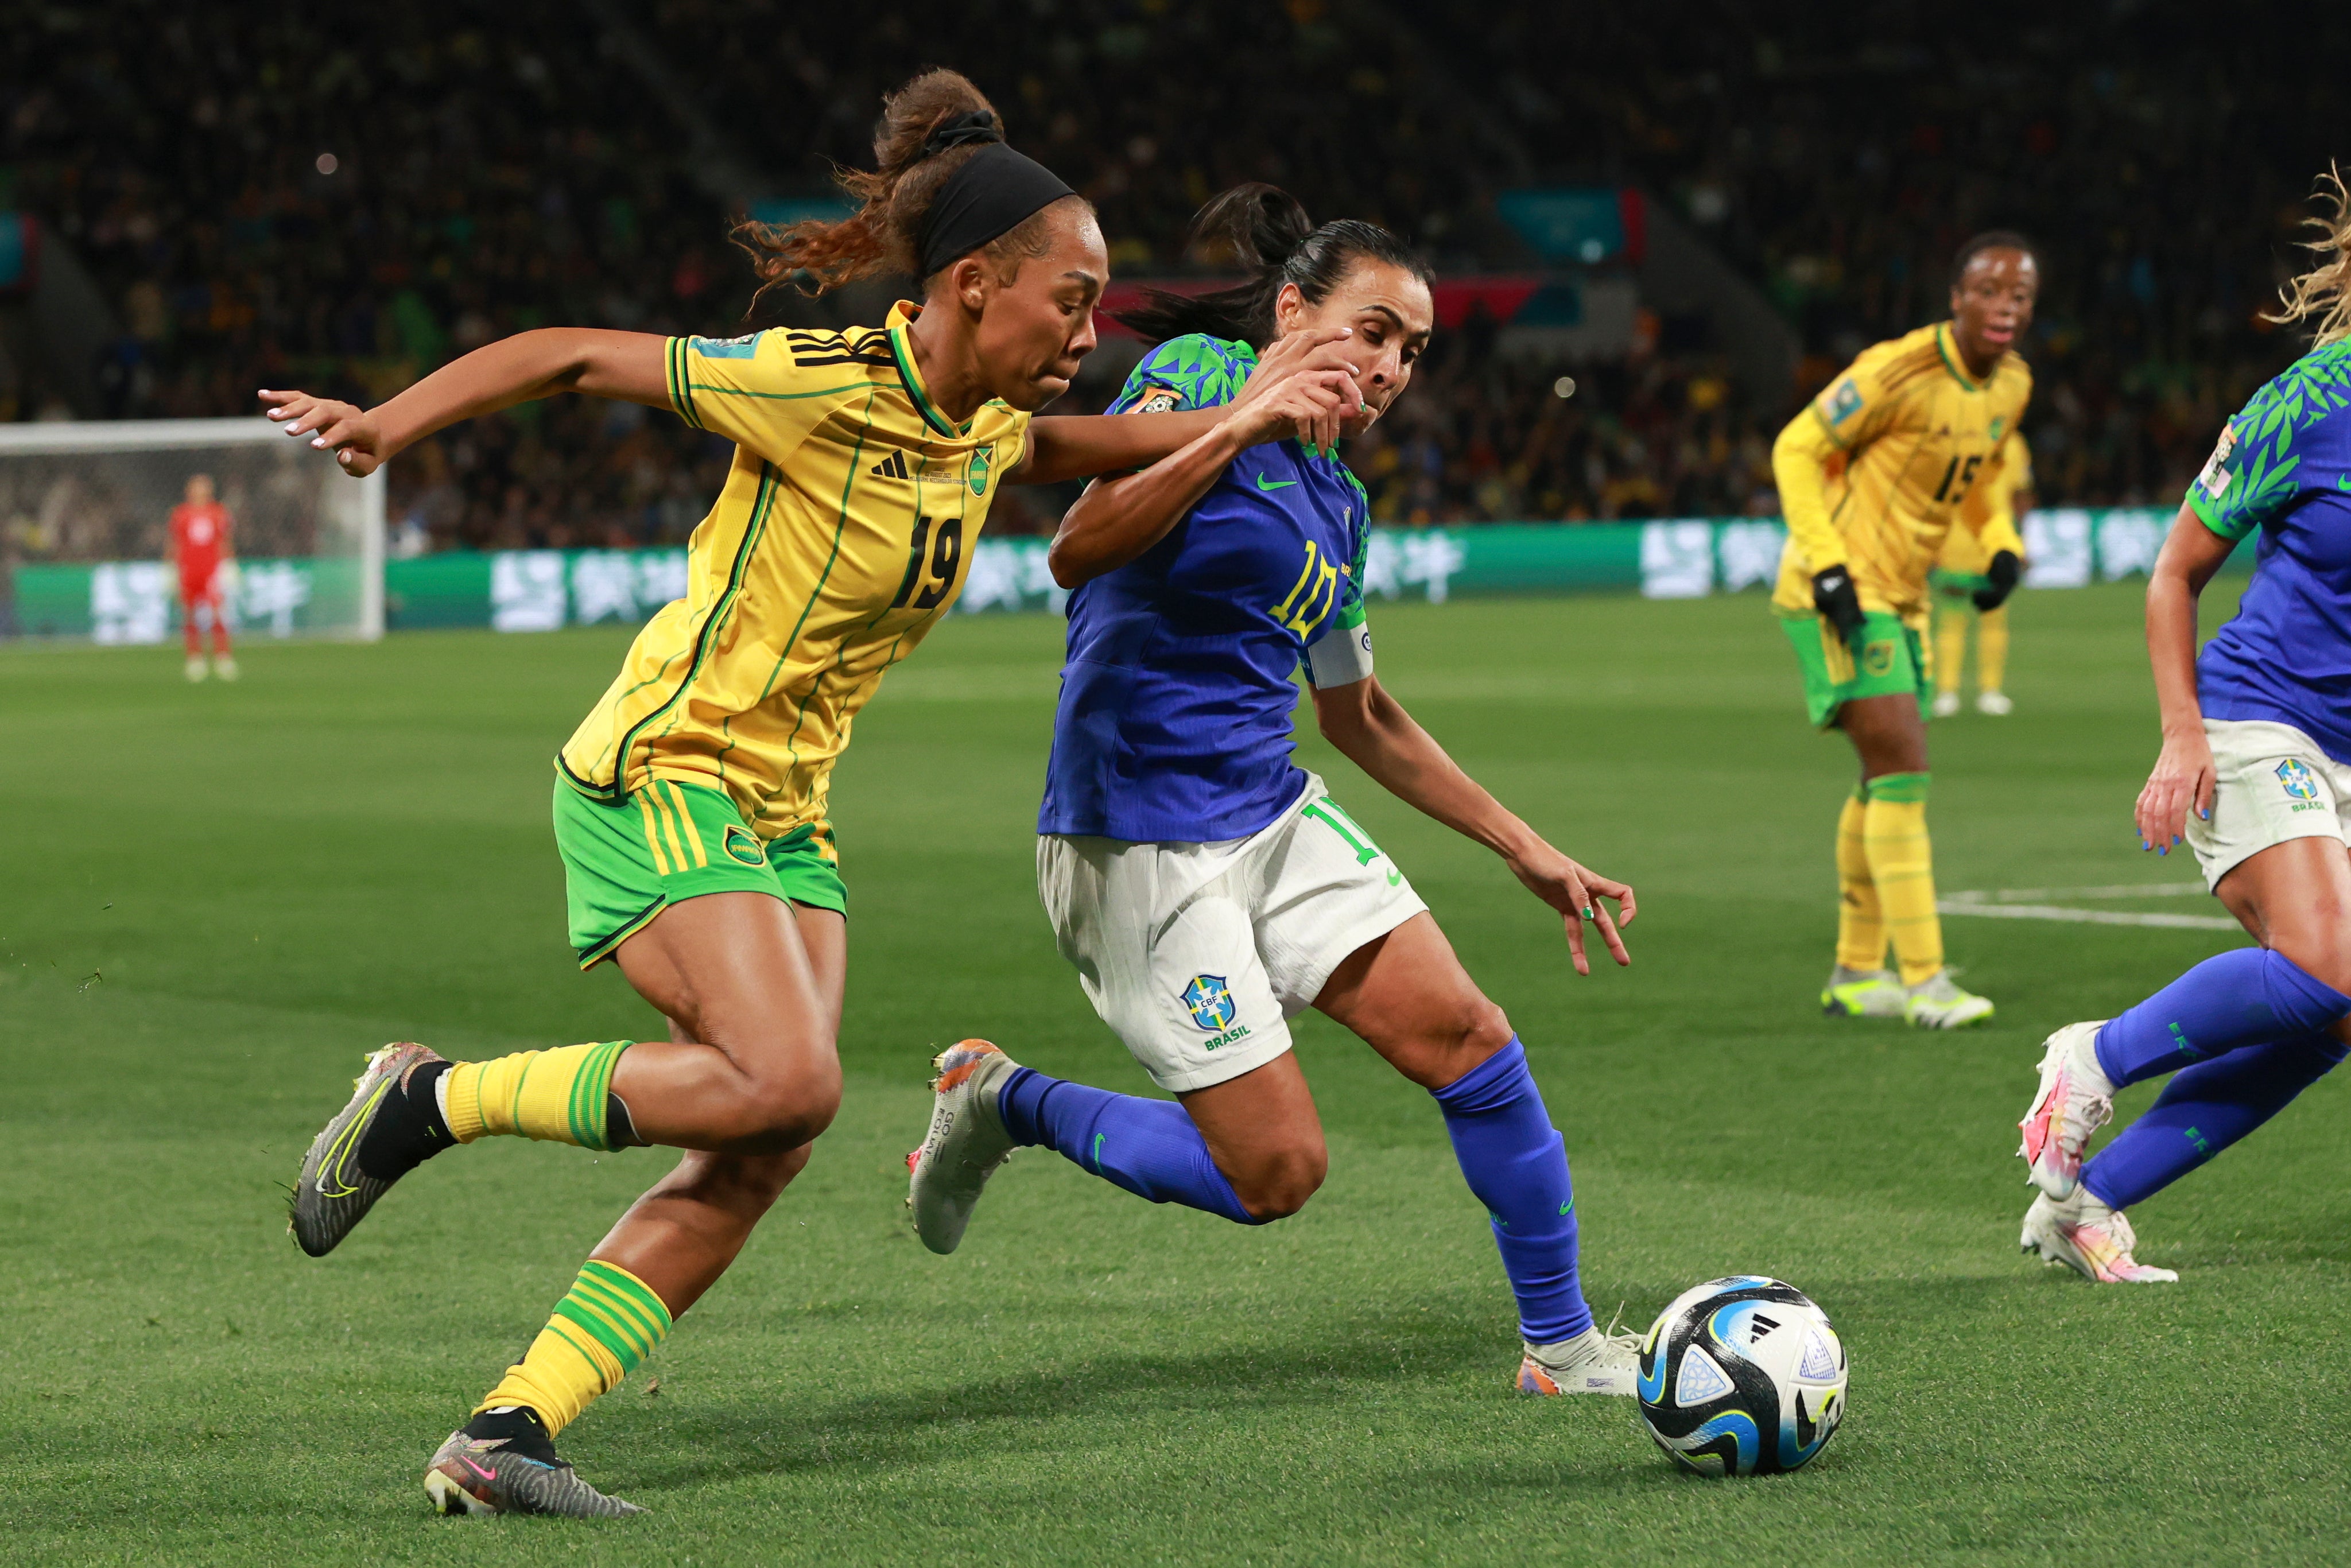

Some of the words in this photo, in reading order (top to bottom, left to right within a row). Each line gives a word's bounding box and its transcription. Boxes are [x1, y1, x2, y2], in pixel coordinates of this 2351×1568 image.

[1934, 455, 1983, 504] 15
[891, 517, 962, 609] 19
[1267, 540, 1337, 645] 10
[1200, 996, 1217, 1008] CBF
[1204, 1025, 1251, 1051] BRASIL
